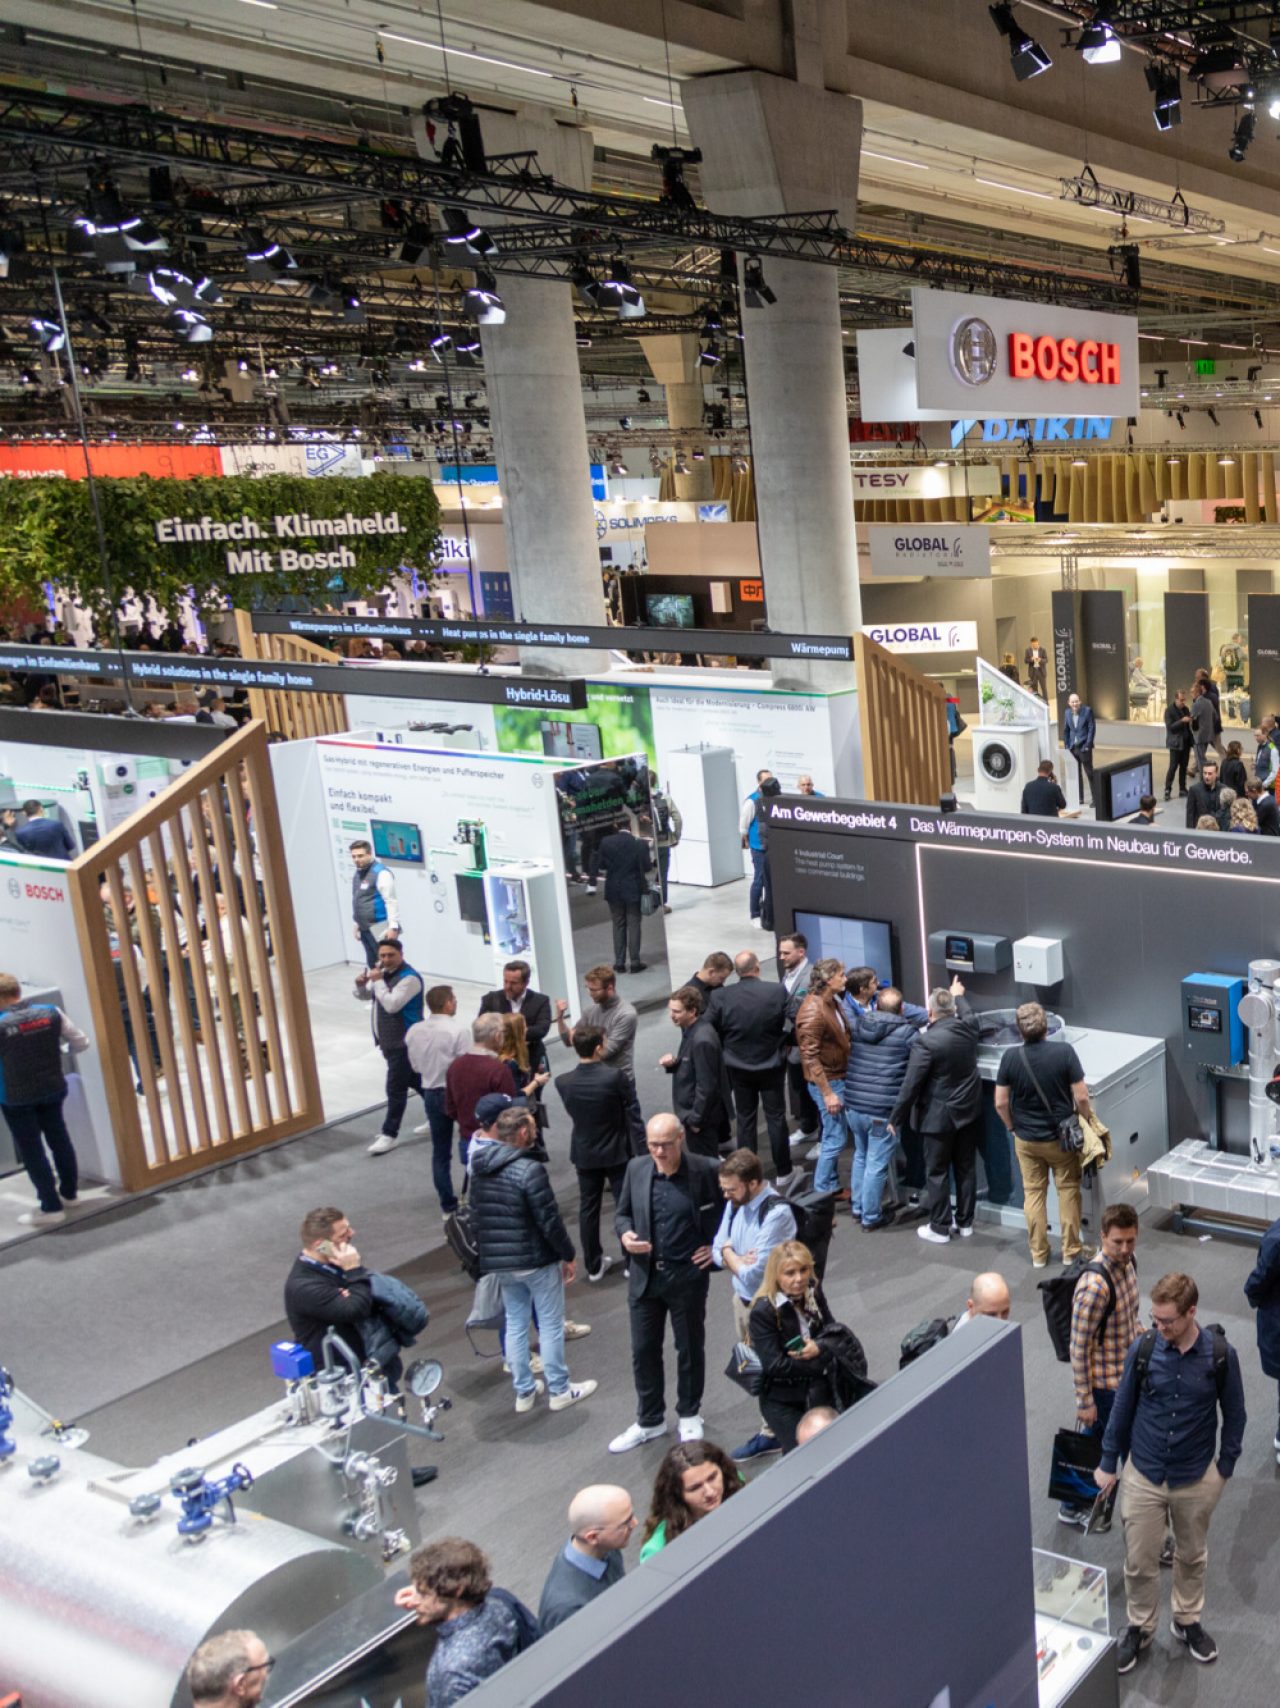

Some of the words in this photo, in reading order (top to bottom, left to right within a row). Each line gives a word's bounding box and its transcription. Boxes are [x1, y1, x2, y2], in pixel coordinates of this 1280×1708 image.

[1009, 332, 1121, 385] BOSCH
[982, 417, 1112, 442] DAIKIN
[854, 473, 910, 488] TESY
[156, 516, 269, 542] Einfach.
[274, 511, 408, 538] Klimaheld.
[894, 537, 950, 551] GLOBAL
[226, 551, 274, 574] Mit
[280, 546, 356, 572] Bosch
[442, 627, 461, 638] Heat
[489, 629, 498, 640] in
[499, 630, 513, 641] the
[514, 631, 538, 643] single
[539, 632, 565, 645] family
[566, 633, 590, 644] home
[870, 627, 942, 643] GLOBAL
[131, 663, 161, 676] Hybrid
[162, 665, 201, 678] solutions
[201, 667, 211, 680] in
[212, 668, 228, 681] the
[229, 669, 256, 684] single
[256, 671, 286, 686] family
[286, 672, 313, 686] home
[1056, 640, 1067, 692] GLOBAL
[771, 805, 792, 819] Am
[794, 807, 887, 829] Gewerbegebiet
[888, 816, 897, 829] 4
[910, 817, 935, 833] Das
[936, 820, 1084, 848] Wärmepumpen-System
[1087, 834, 1104, 850] im
[1107, 836, 1160, 855] Neubau
[1163, 841, 1182, 857] für
[1185, 844, 1253, 865] Gewerbe.
[25, 884, 64, 902] BOSCH
